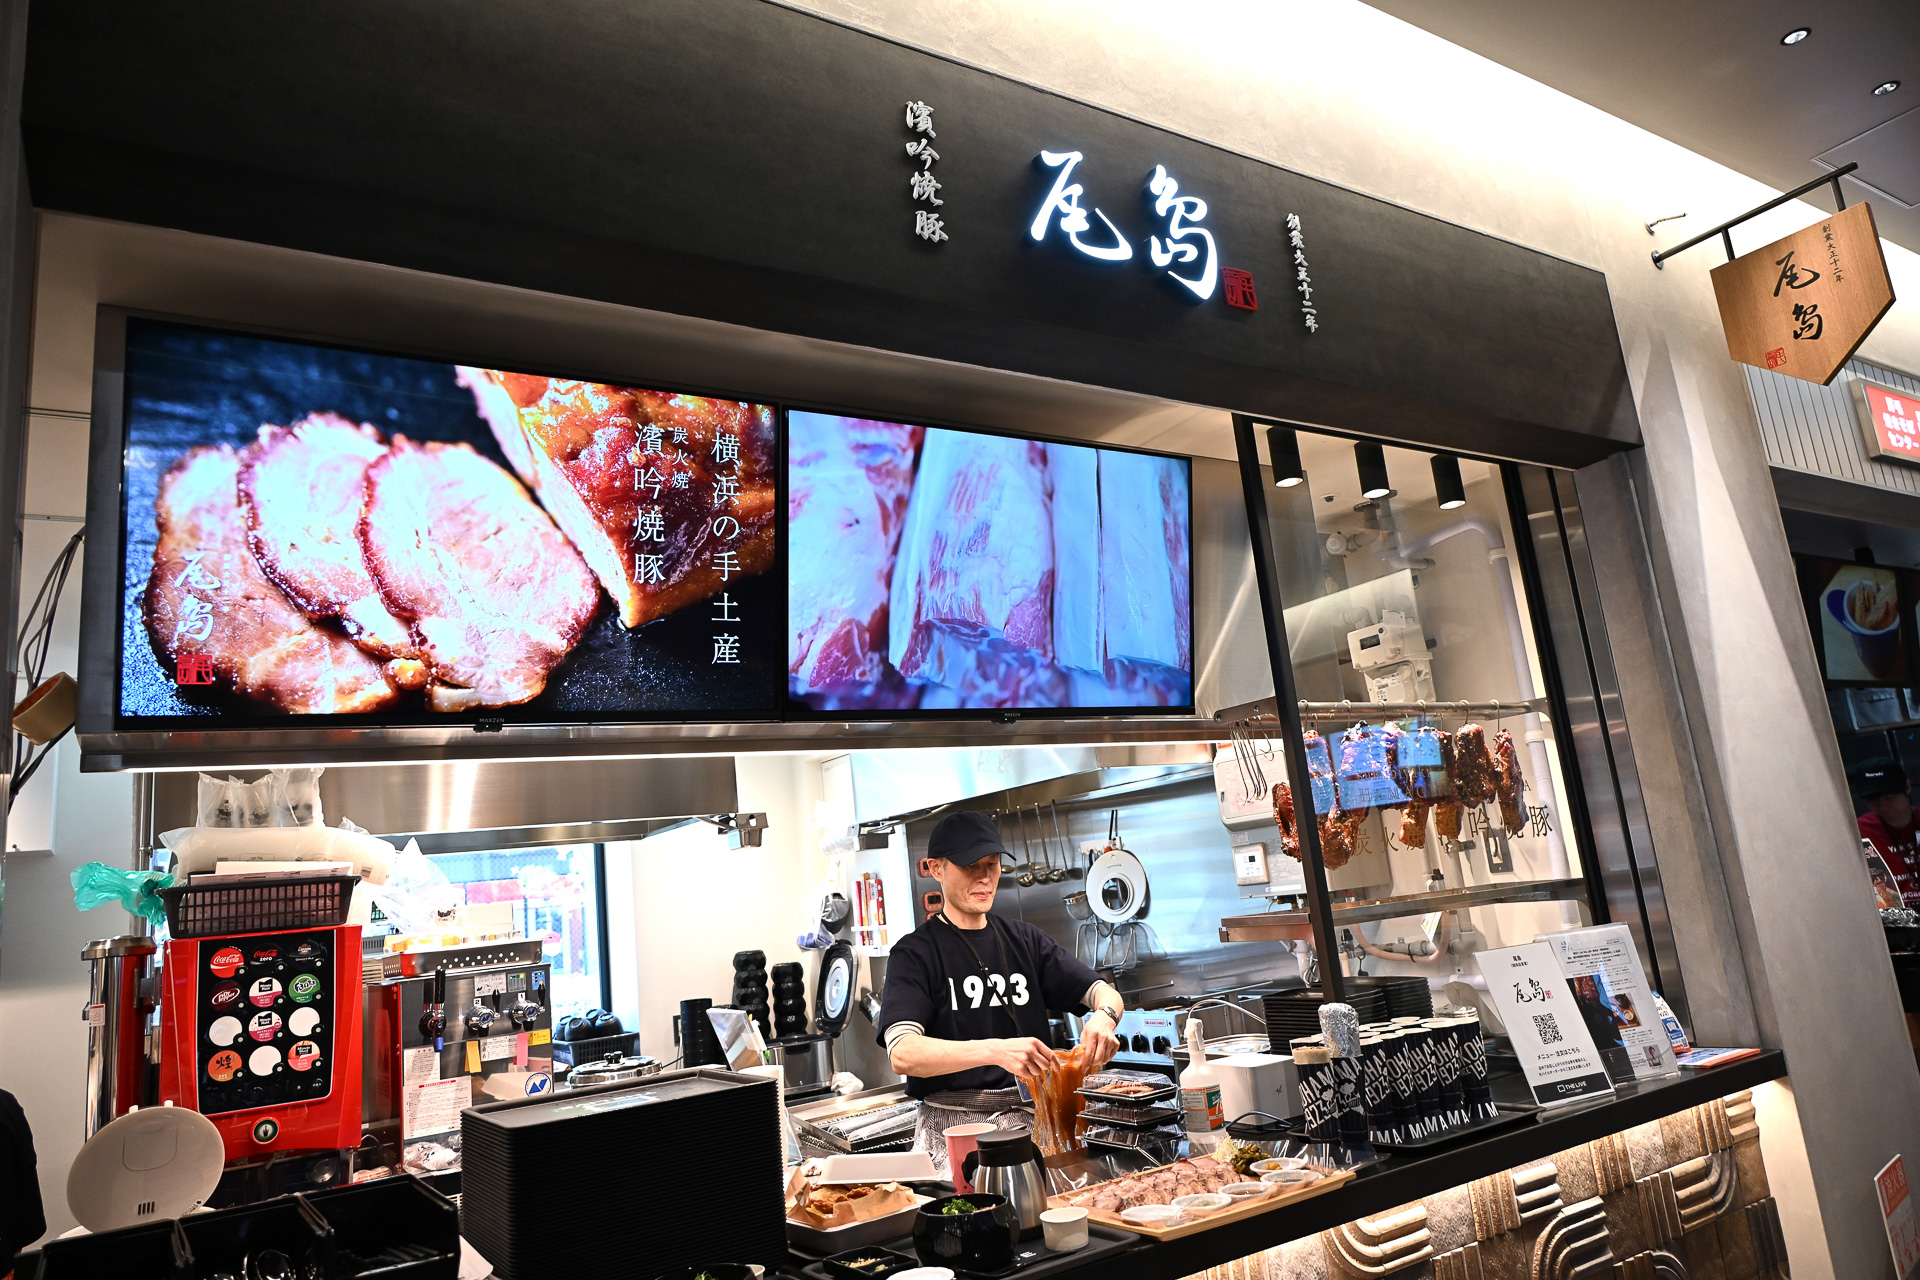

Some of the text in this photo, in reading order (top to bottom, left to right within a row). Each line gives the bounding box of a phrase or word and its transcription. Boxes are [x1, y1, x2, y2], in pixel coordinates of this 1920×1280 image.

[905, 100, 949, 243] 濱吟焼豚
[1822, 223, 1844, 283] 創業大正十二年
[632, 422, 666, 585] 濱吟焼豚
[671, 426, 689, 489] 炭火焼
[711, 432, 741, 665] 横浜の手土産
[948, 972, 1030, 1011] 1923
